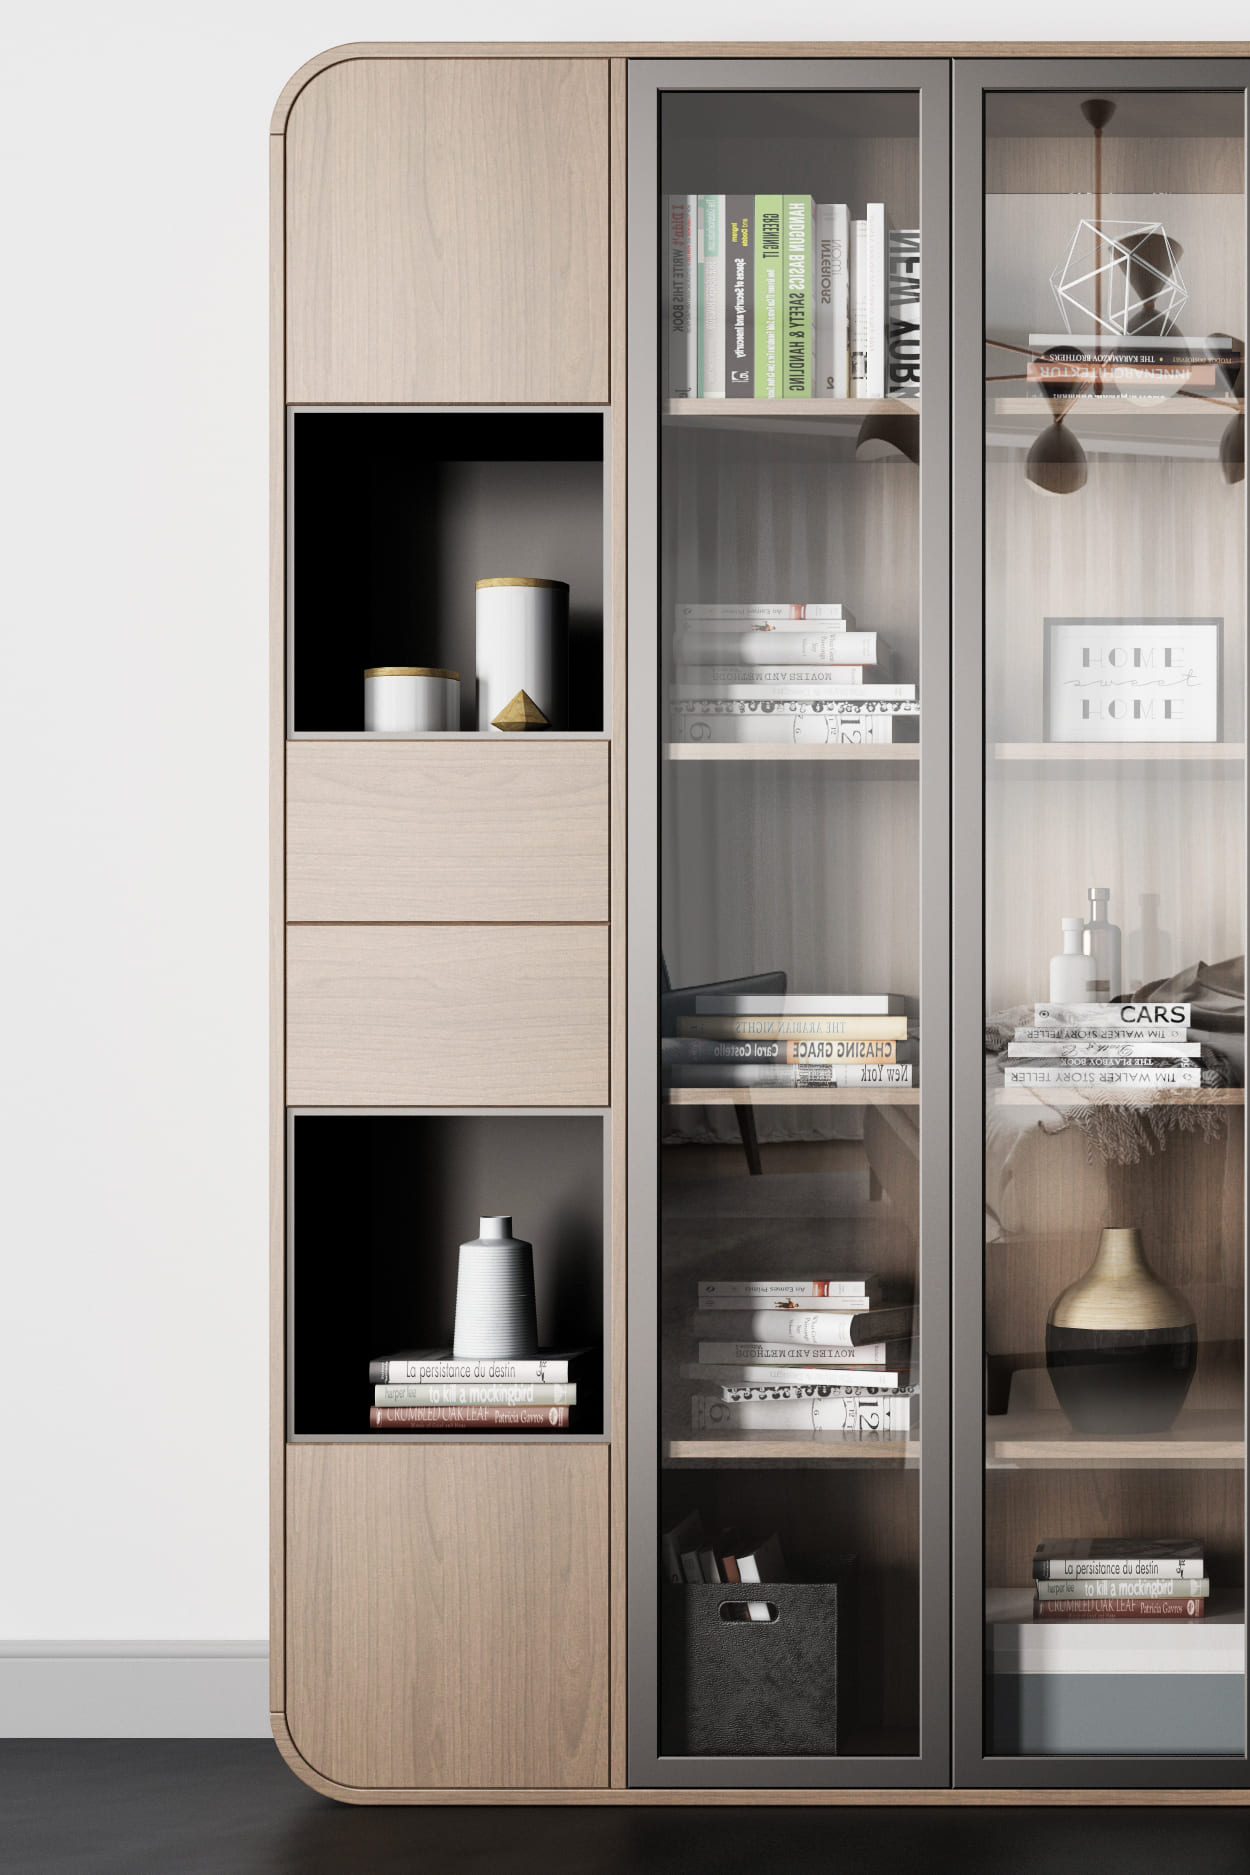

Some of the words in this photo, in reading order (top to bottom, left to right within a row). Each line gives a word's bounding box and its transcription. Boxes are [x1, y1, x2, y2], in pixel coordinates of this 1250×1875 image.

[1050, 354, 1091, 362] BROTHERS
[1140, 354, 1155, 363] THE
[1081, 647, 1185, 667] HOME
[712, 673, 762, 681] METHODS
[765, 673, 786, 681] AND
[790, 673, 832, 681] MOVIES
[1064, 668, 1201, 686] sweet
[1081, 699, 1185, 719] HOME
[1121, 1006, 1185, 1023] CARS
[1026, 1030, 1062, 1038] TELLER
[1064, 1030, 1098, 1038] STORY
[1101, 1030, 1143, 1038] WALKER
[1148, 1030, 1165, 1038] TIM
[1011, 1072, 1051, 1082] TELLER
[1056, 1072, 1093, 1082] STORY
[1099, 1072, 1150, 1082] WALKER
[1155, 1072, 1176, 1082] TIM
[736, 1350, 786, 1358] METHODS
[788, 1350, 809, 1358] AND
[812, 1350, 854, 1358] MOVIES
[407, 1361, 416, 1378] La
[419, 1361, 471, 1383] persistance
[474, 1360, 485, 1378] du
[489, 1361, 516, 1378] destin
[429, 1386, 439, 1403] to
[443, 1385, 457, 1403] kill
[459, 1389, 466, 1403] a
[469, 1384, 534, 1405] mockingbird
[387, 1407, 441, 1421] CRUMBLED
[443, 1407, 464, 1421] OAK
[467, 1407, 490, 1420] LEAF
[859, 1401, 880, 1430] 12
[1065, 1560, 1074, 1575] La
[1076, 1560, 1120, 1580] persistance
[1122, 1560, 1133, 1574] du
[1136, 1560, 1159, 1574] destin
[1085, 1583, 1093, 1596] to
[1096, 1580, 1108, 1596] kill
[1111, 1585, 1116, 1596] a
[1119, 1580, 1173, 1597] mockingbird
